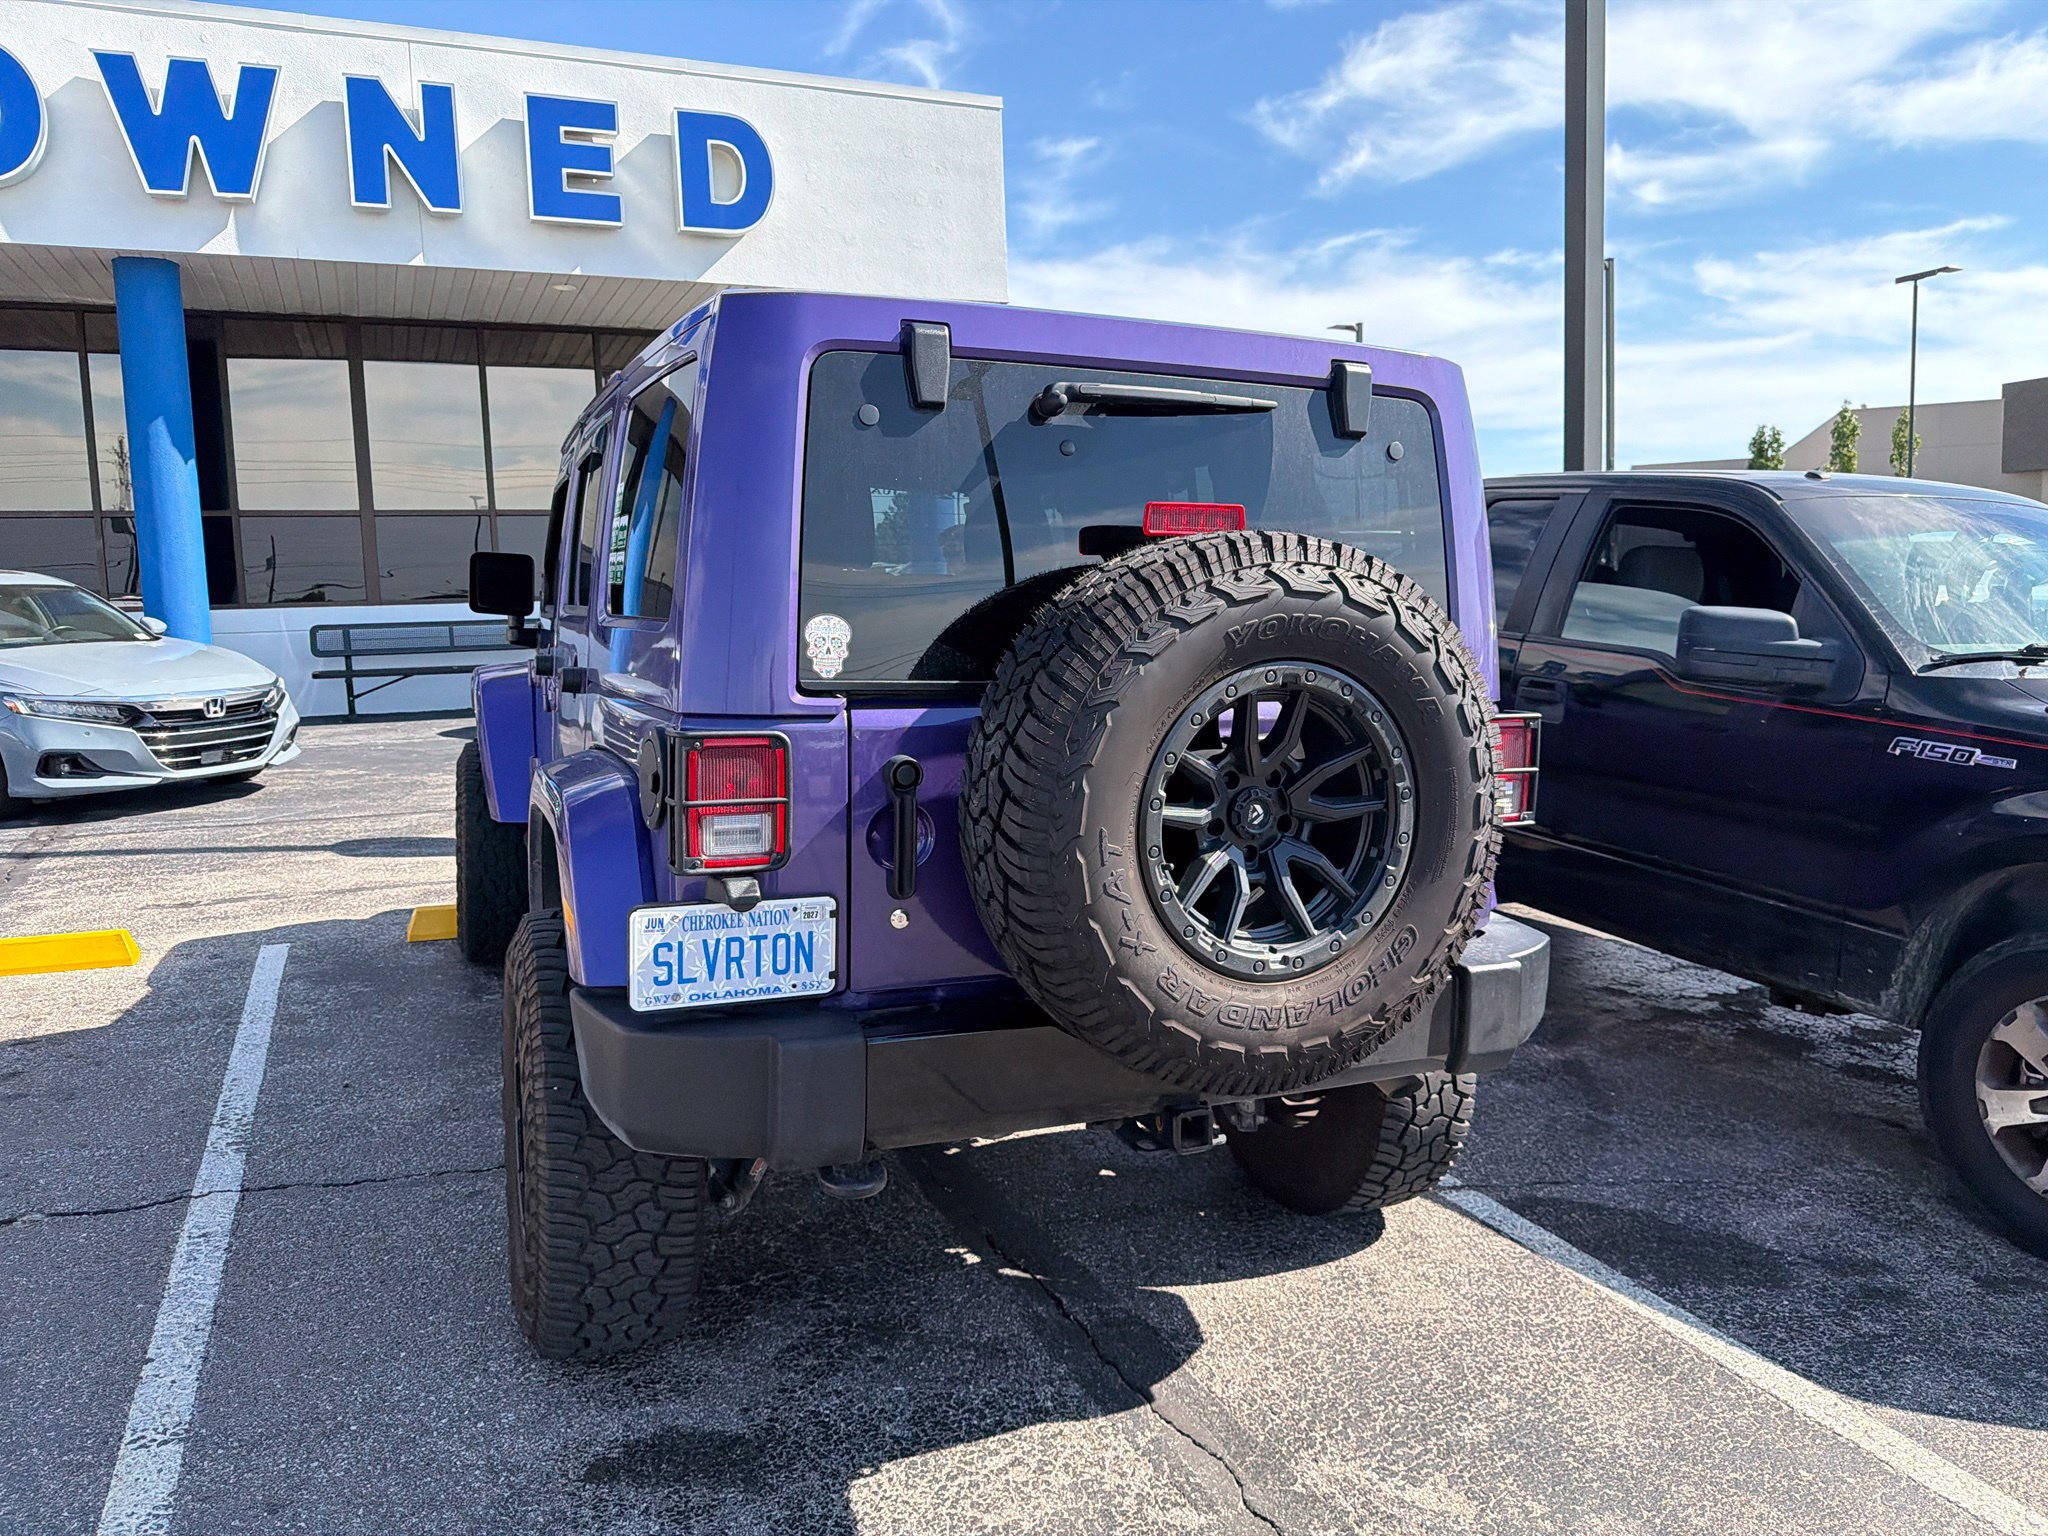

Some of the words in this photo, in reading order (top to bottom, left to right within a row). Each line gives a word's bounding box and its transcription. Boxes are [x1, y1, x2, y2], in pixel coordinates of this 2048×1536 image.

[682, 912, 744, 932] CHEROKEE
[749, 909, 790, 928] NATION
[802, 911, 819, 920] 2027
[645, 917, 665, 930] JUN
[653, 931, 814, 987] SLVRTON
[688, 986, 782, 1001] OKLAHOMA
